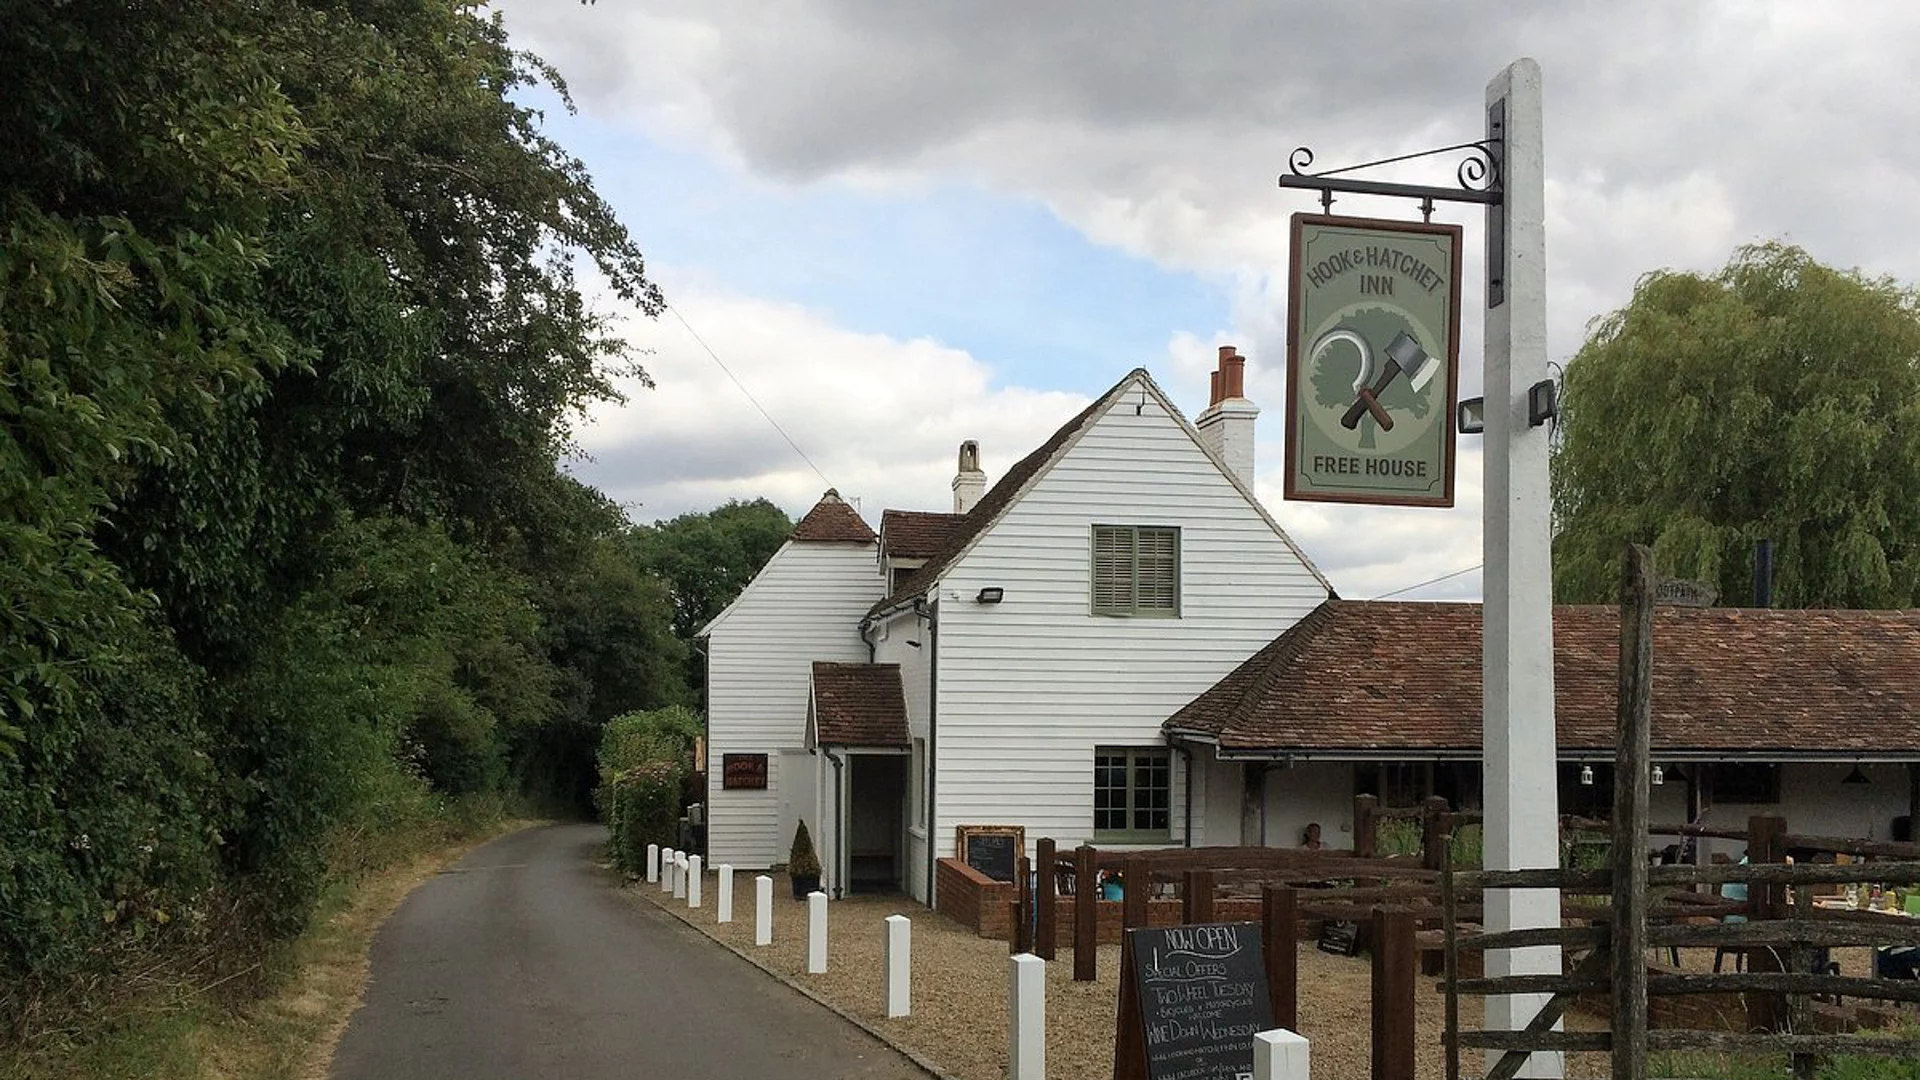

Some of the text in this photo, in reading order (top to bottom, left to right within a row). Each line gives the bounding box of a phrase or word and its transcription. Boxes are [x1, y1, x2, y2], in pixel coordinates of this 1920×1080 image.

[1307, 249, 1353, 288] HOOK
[1366, 246, 1444, 294] HATCHET
[1360, 274, 1394, 295] INN
[1314, 455, 1427, 478] FREE HOUSE
[1164, 926, 1238, 951] NOW OPEN
[1185, 960, 1227, 978] OFFERS
[1150, 986, 1178, 1004] TWO
[1146, 1022, 1169, 1046] WINE
[1169, 1019, 1199, 1041] DOWN
